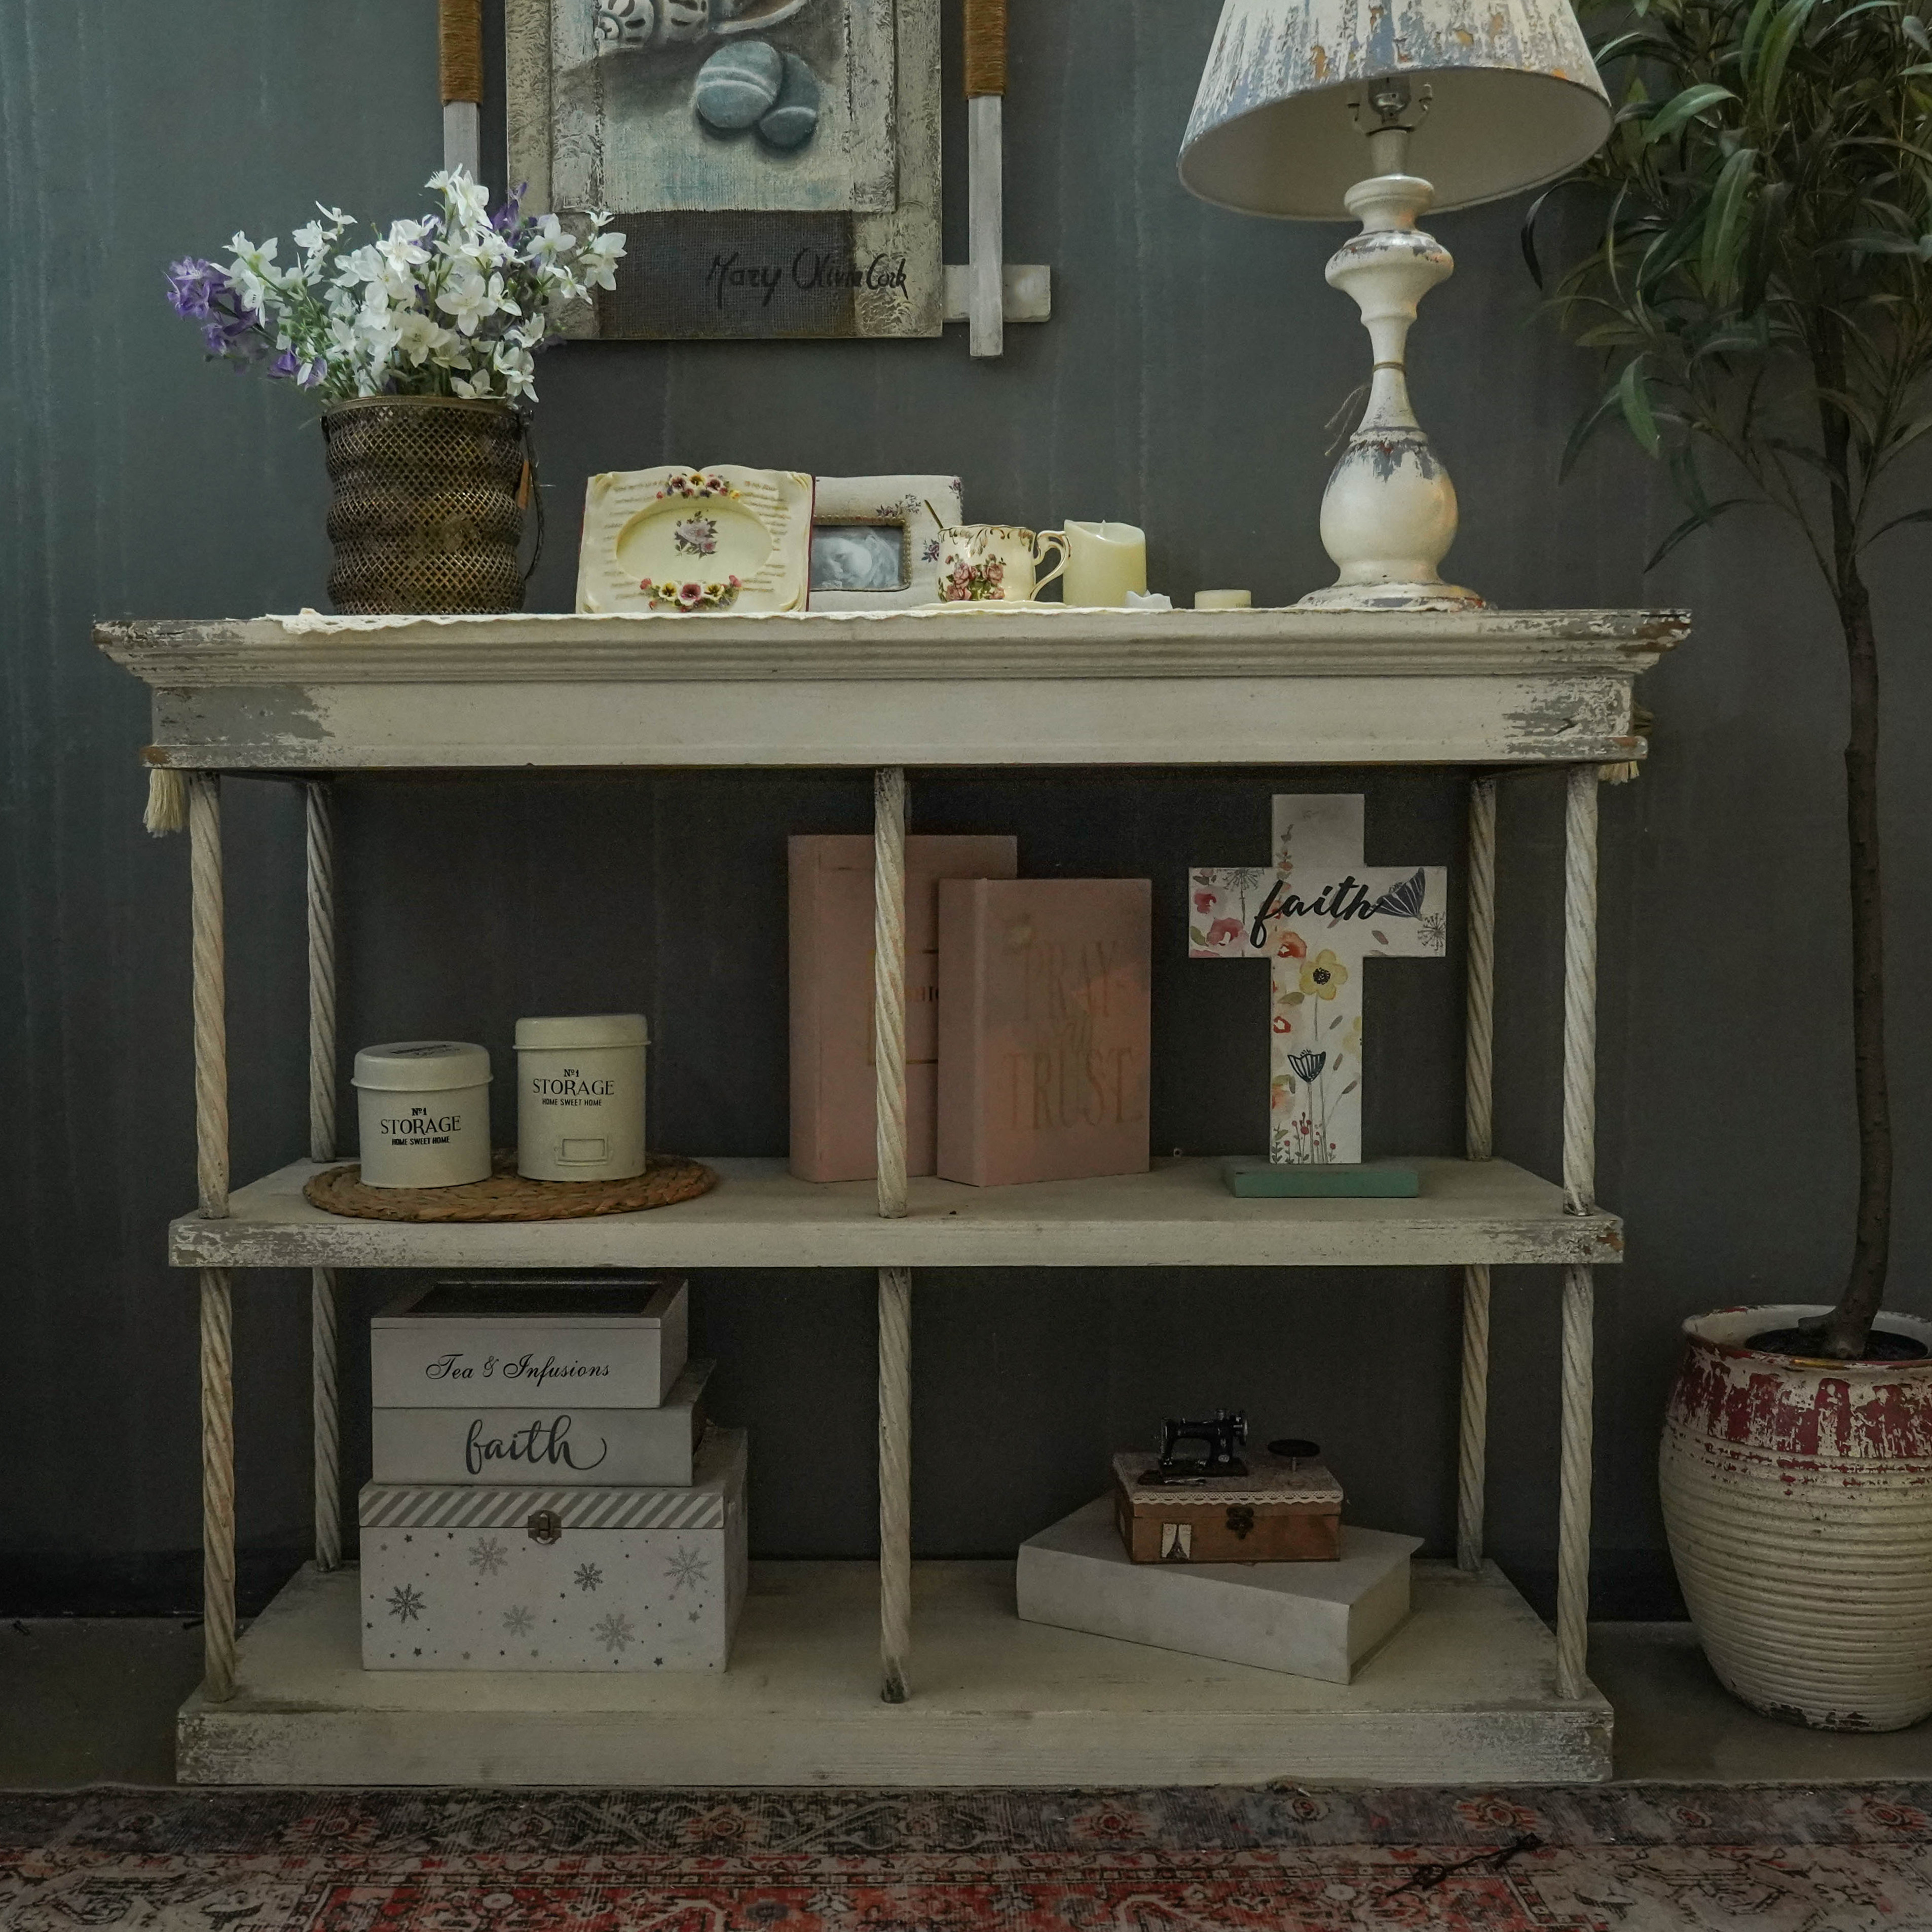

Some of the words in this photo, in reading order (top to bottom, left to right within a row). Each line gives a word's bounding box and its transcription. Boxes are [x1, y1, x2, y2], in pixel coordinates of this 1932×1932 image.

[706, 251, 782, 309] Mary
[1249, 875, 1384, 949] faith
[533, 1078, 615, 1096] STORAGE
[542, 1098, 558, 1106] HOME
[560, 1098, 582, 1106] SWEET
[1003, 1046, 1133, 1130] TRUST
[380, 1116, 462, 1135] STORAGE
[410, 1137, 431, 1145] SWEET
[432, 1136, 450, 1144] HOME
[426, 1354, 475, 1380] Tea
[482, 1355, 499, 1378] &
[503, 1353, 610, 1387] Infusions
[465, 1415, 607, 1475] faith
